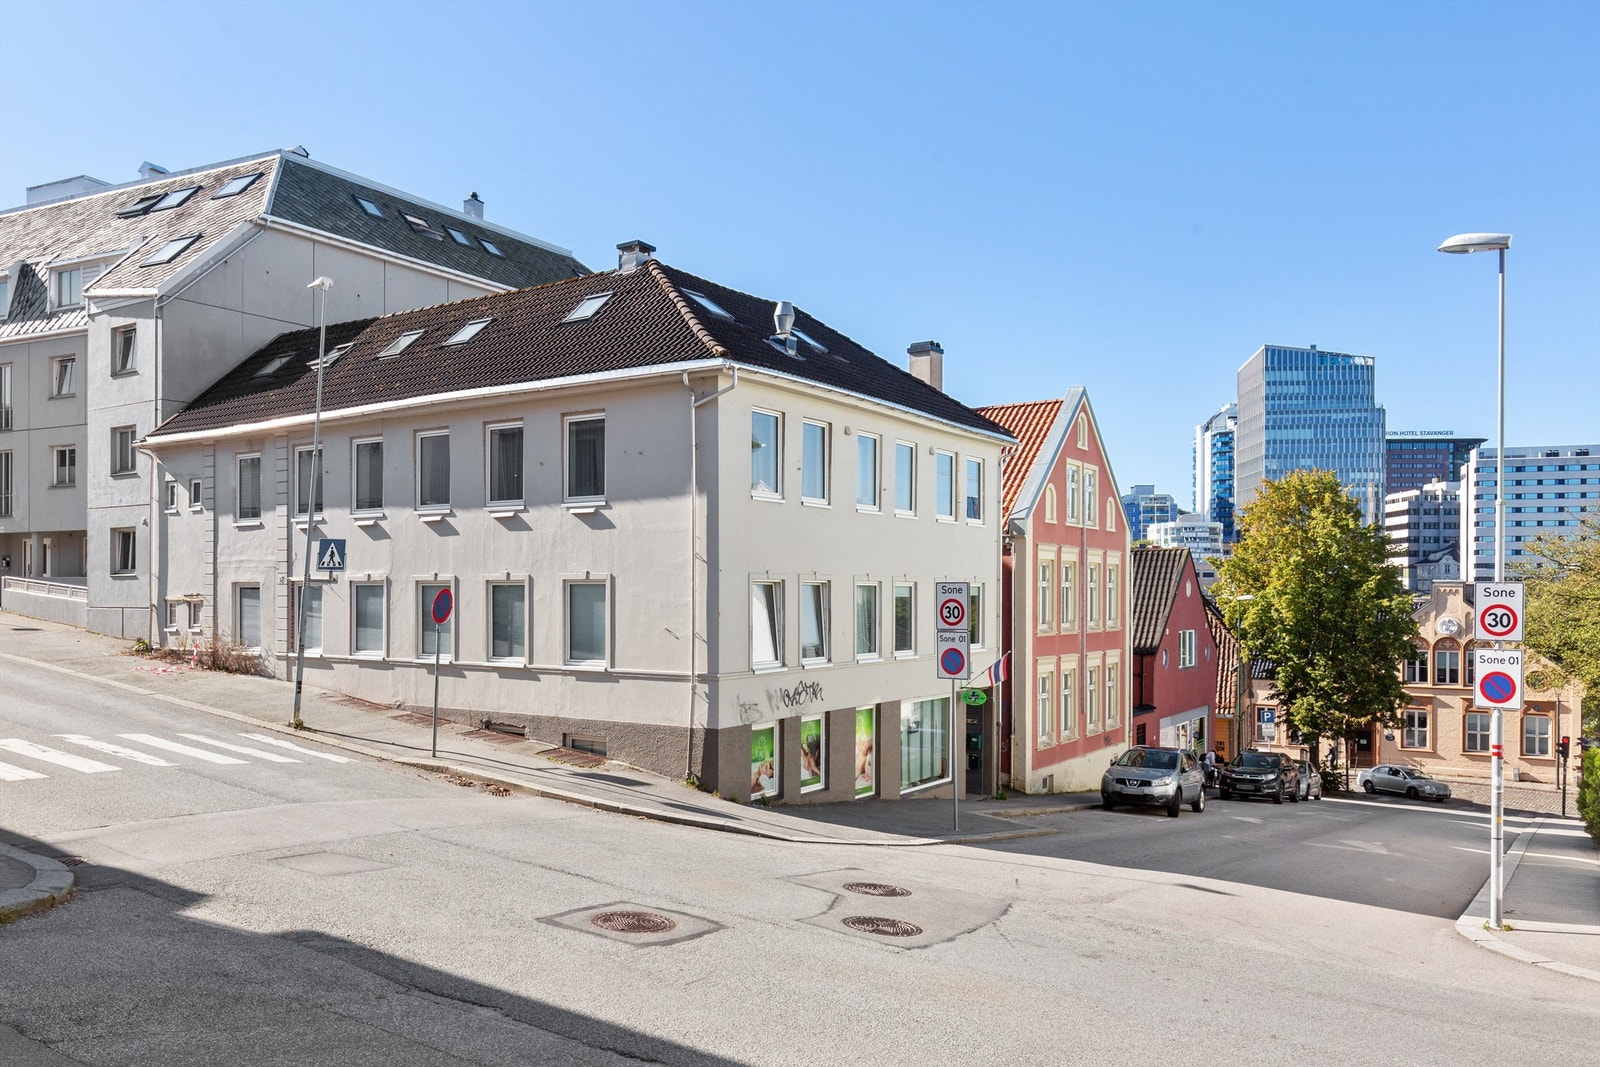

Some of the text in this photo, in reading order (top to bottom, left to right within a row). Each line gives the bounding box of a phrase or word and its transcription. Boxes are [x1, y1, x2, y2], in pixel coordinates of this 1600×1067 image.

[942, 586, 962, 594] Sone
[1484, 588, 1516, 598] Sone
[944, 606, 960, 620] 30
[1487, 612, 1511, 628] 30
[1479, 655, 1519, 666] Sone 01
[1264, 712, 1271, 722] P
